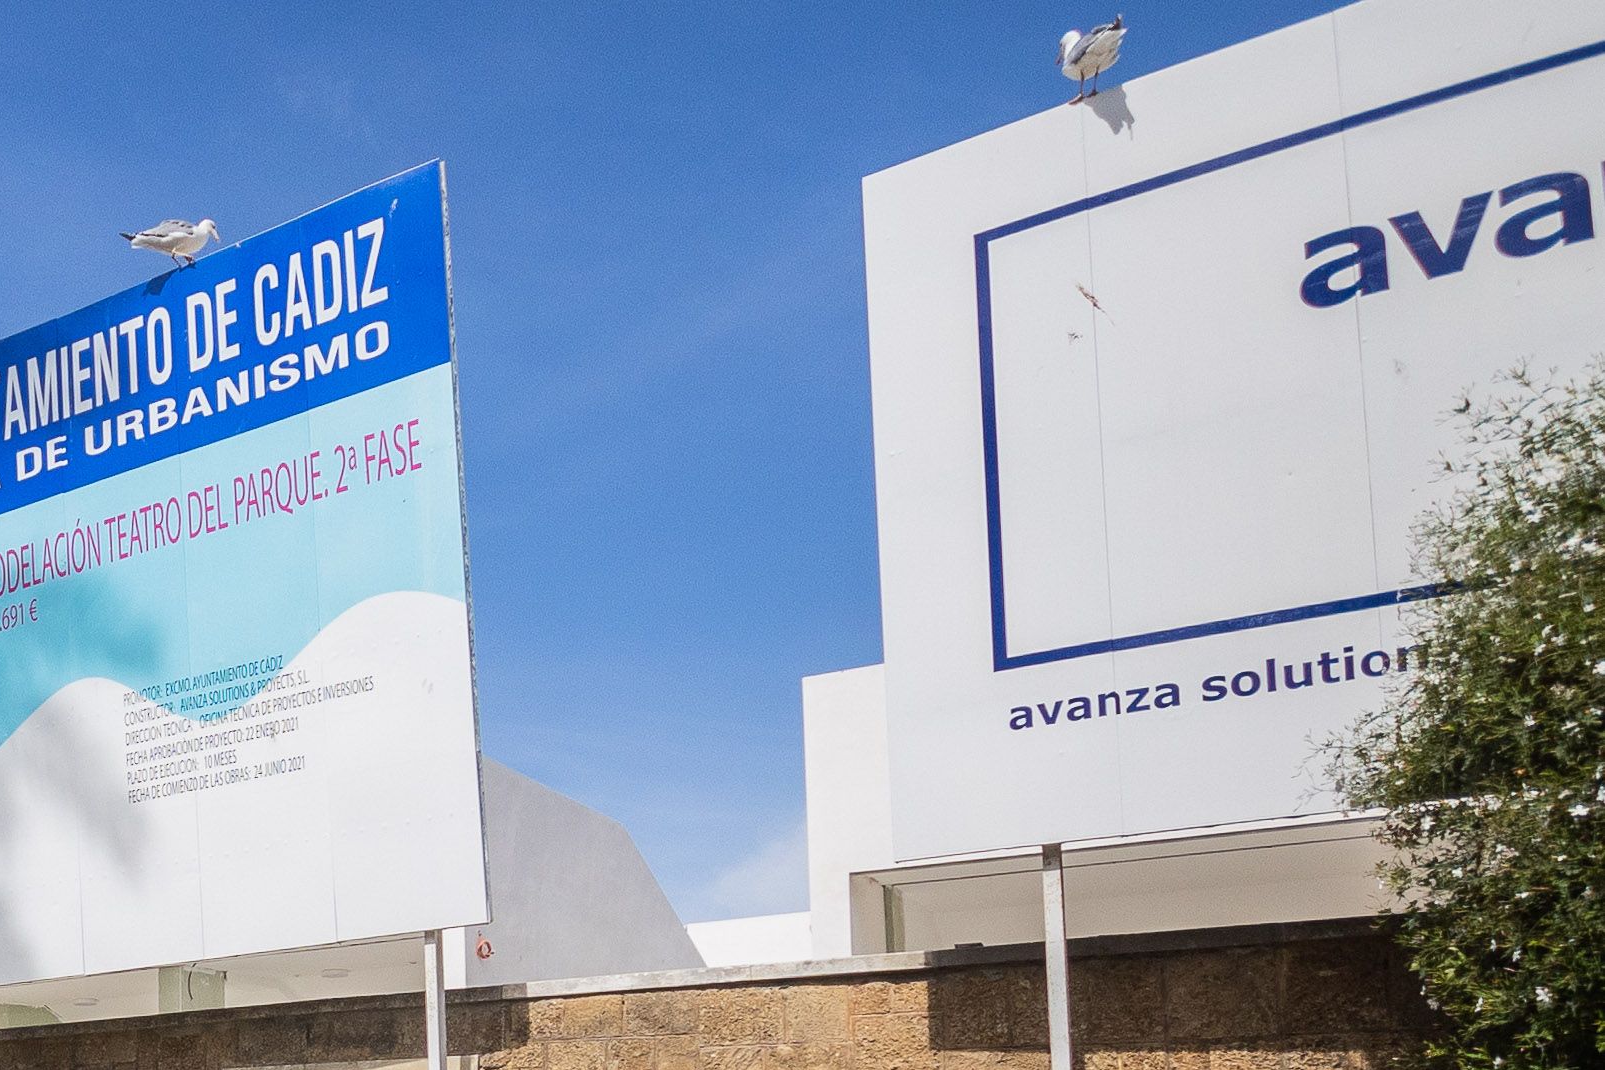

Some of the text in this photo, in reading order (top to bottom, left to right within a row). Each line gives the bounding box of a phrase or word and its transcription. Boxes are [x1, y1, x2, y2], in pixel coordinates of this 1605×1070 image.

[1299, 161, 1605, 309] ava
[186, 278, 240, 373] DE
[253, 216, 389, 346] CADIZ
[16, 435, 68, 482] DE
[84, 320, 390, 456] URBANISMO
[104, 497, 182, 562] TEATRO
[187, 483, 228, 539] DEL
[233, 450, 329, 525] PARQUE.
[363, 418, 422, 485] FASE
[28, 598, 38, 622] €
[180, 692, 209, 712] AVANZA
[209, 681, 249, 705] SOLUTIONS
[250, 681, 256, 696] &
[192, 664, 248, 690] AYUNTAMIENTO
[249, 661, 259, 677] DE
[199, 708, 228, 728] OFICINA
[261, 700, 271, 716] DE
[273, 689, 316, 711] PROYECTOS
[317, 688, 322, 702] E
[322, 675, 374, 700] INVERSIONES
[1009, 682, 1181, 730] avanza
[126, 750, 148, 766] FECHA
[194, 736, 203, 752] DE
[246, 726, 255, 741] 22
[256, 720, 280, 738] ENERO
[282, 716, 299, 734] 2021
[127, 768, 148, 785] PLAZO
[149, 765, 158, 780] DE
[204, 754, 212, 769] 10
[213, 749, 237, 767] MESES
[128, 787, 150, 804] FECHA
[151, 784, 160, 799] DE
[162, 776, 198, 797] COMIENZO
[199, 774, 209, 790] DE
[210, 771, 223, 787] LAS
[254, 763, 263, 778] 24
[264, 758, 287, 777] JUNIO
[288, 755, 305, 772] 2021
